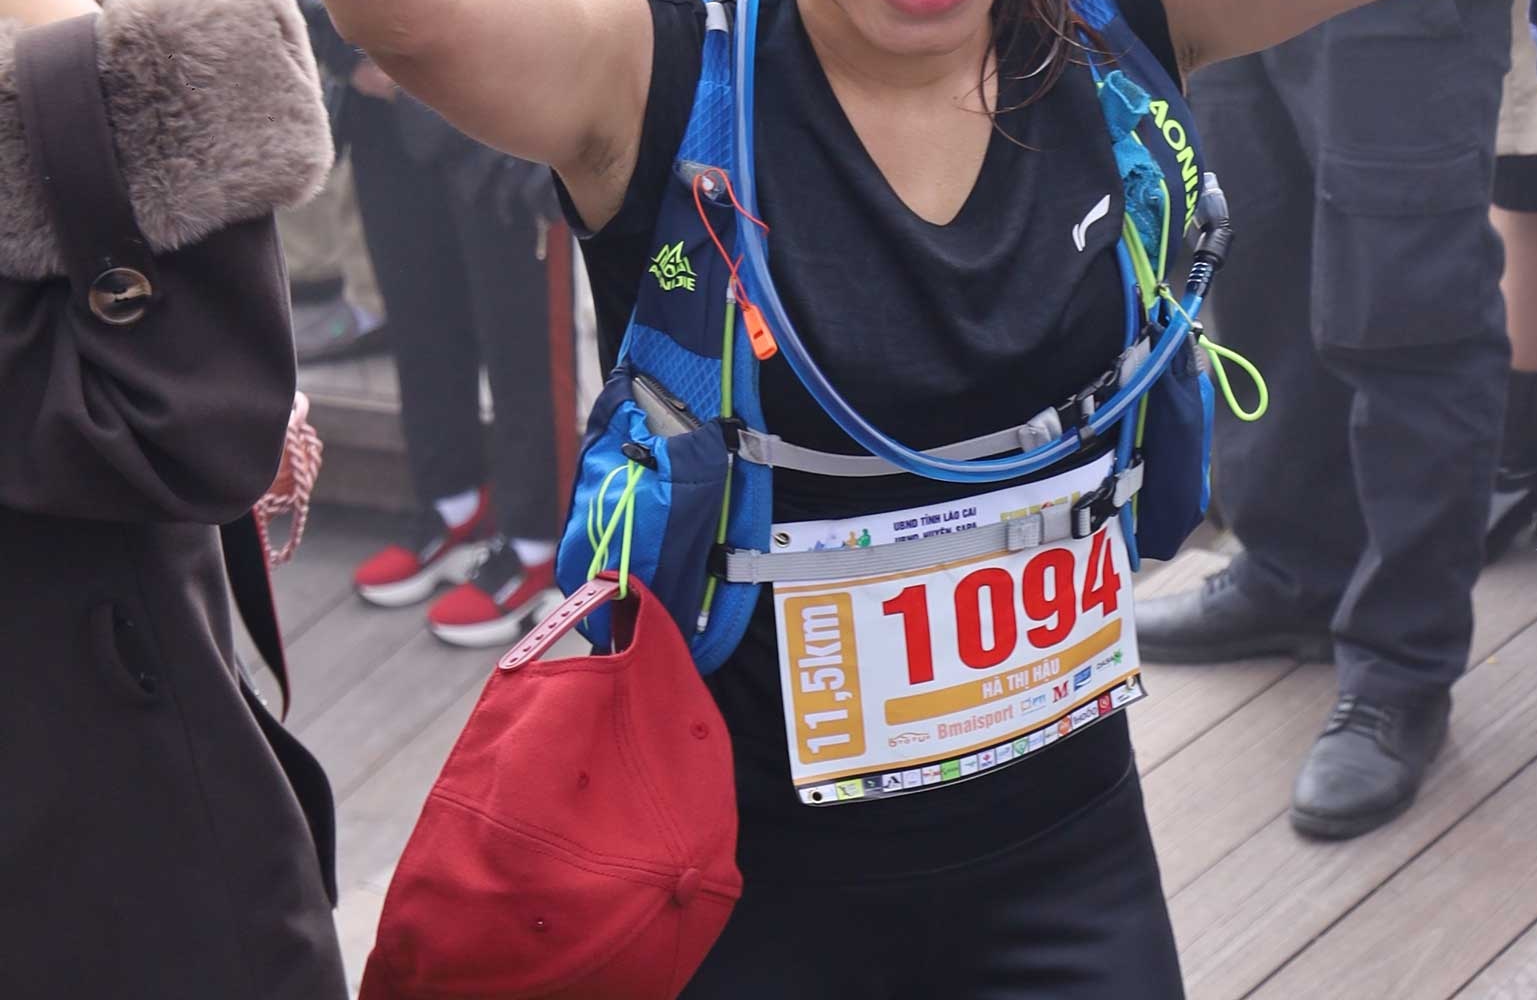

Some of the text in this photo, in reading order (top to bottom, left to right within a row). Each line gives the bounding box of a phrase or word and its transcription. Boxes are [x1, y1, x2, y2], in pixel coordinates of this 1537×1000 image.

[797, 604, 853, 754] 11,5km
[882, 526, 1122, 686] 1094
[937, 704, 1015, 740] Bmaisport
